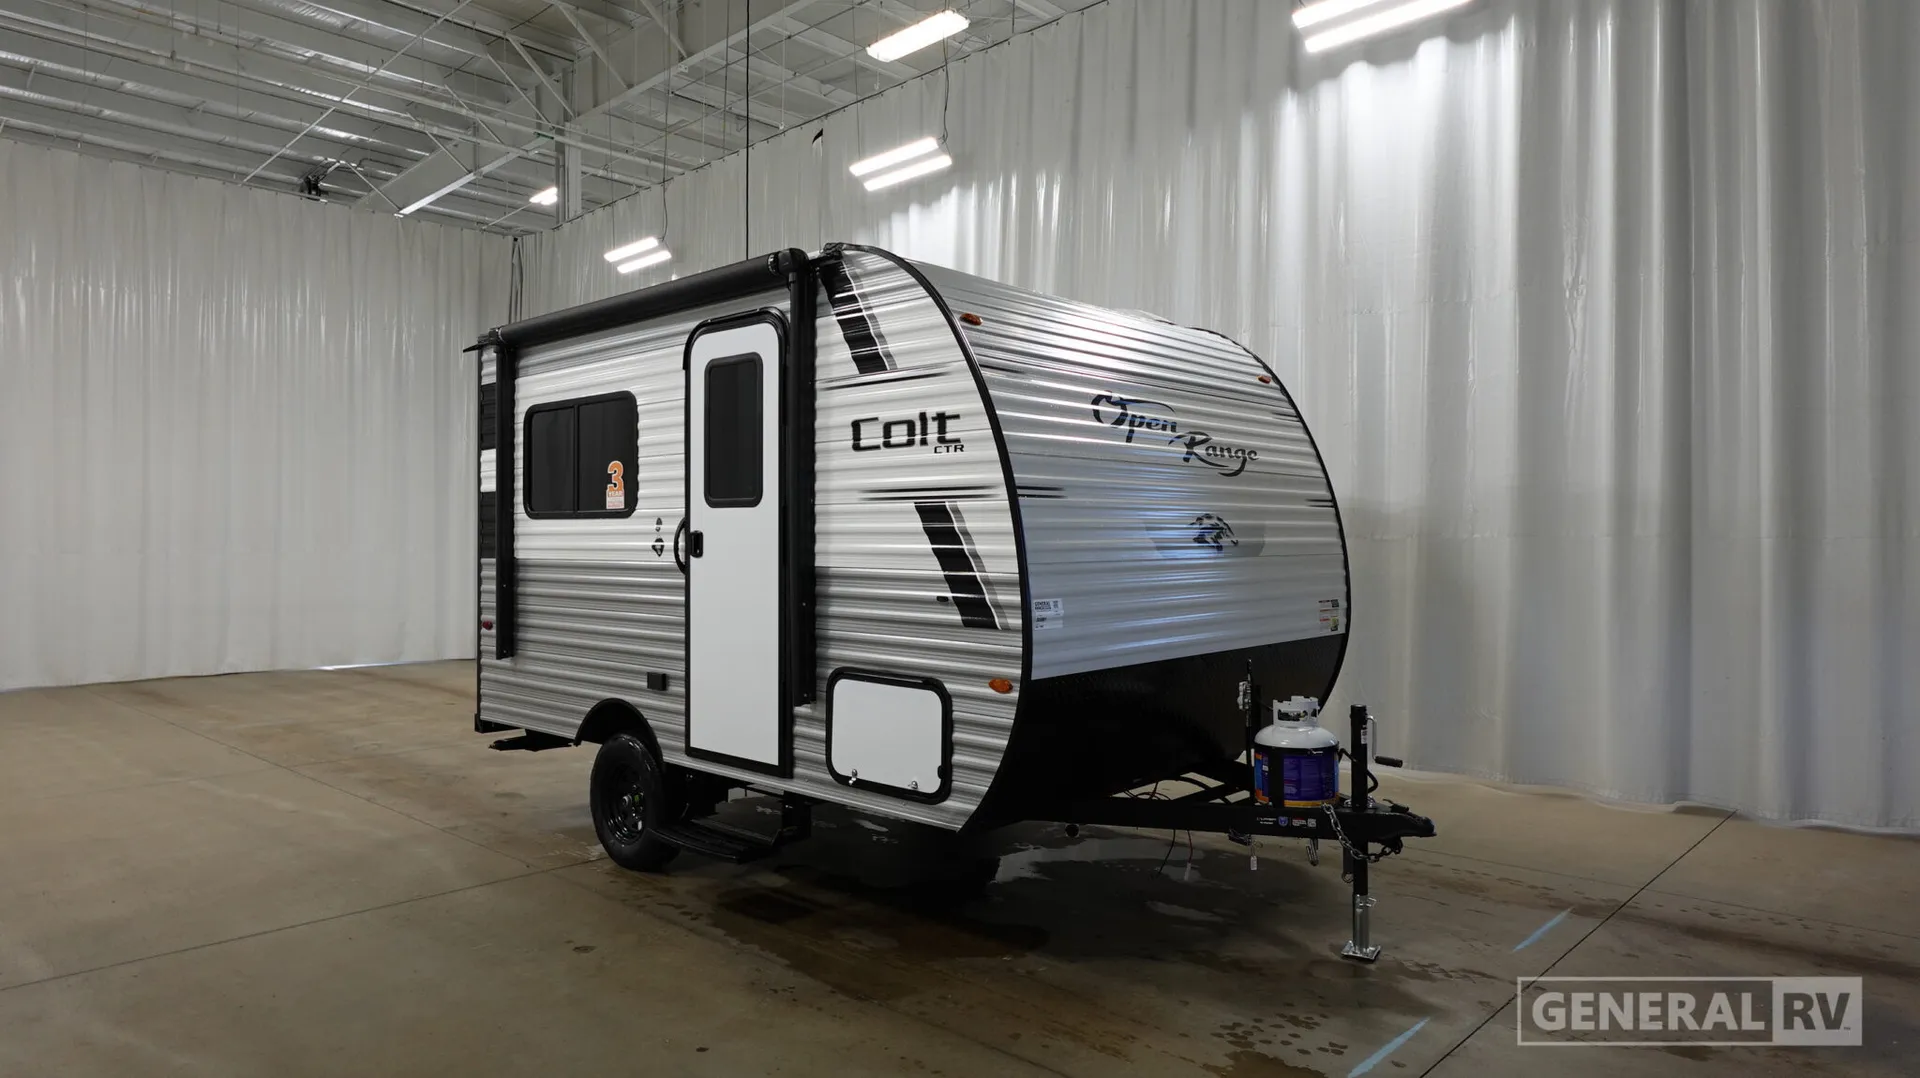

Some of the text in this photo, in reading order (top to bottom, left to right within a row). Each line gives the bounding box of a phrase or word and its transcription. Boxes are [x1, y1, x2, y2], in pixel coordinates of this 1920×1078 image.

[851, 411, 961, 452] Colt
[1091, 390, 1177, 443] Open
[934, 444, 965, 454] CTR
[1168, 431, 1259, 477] Range
[607, 460, 624, 492] 3
